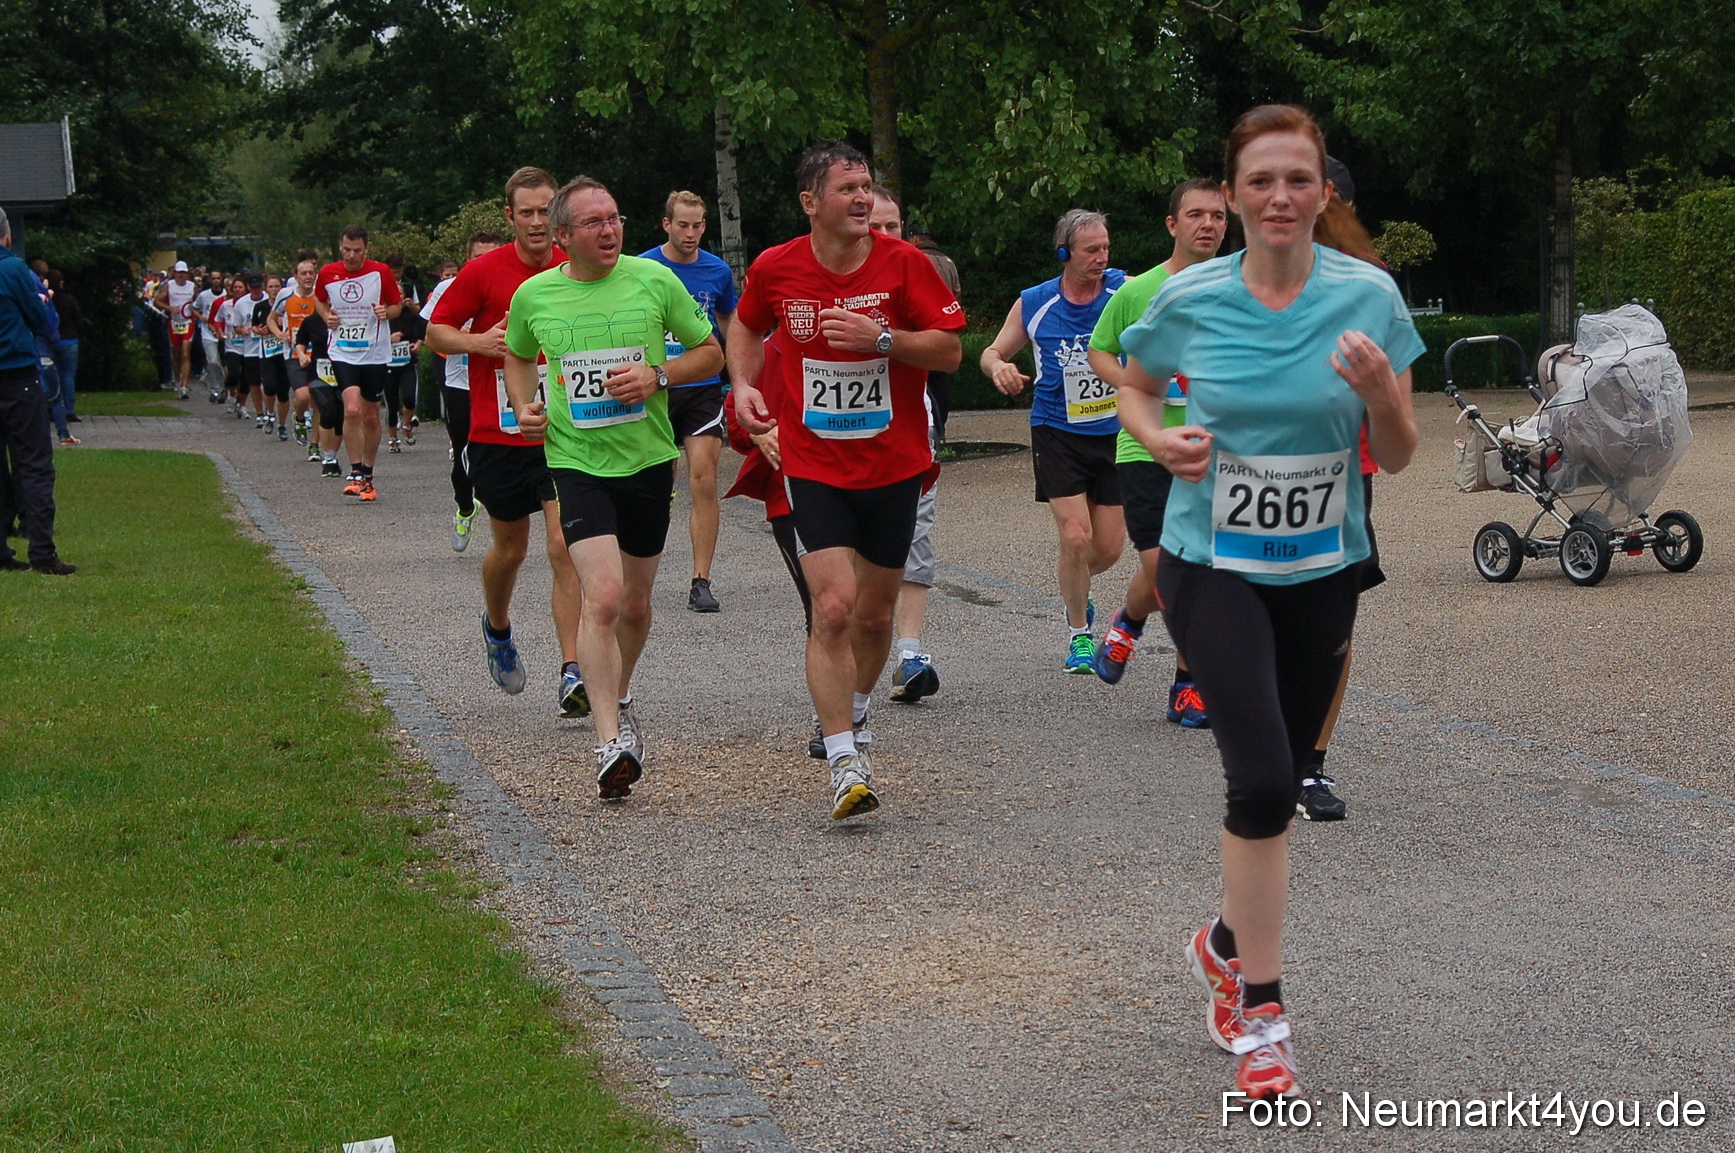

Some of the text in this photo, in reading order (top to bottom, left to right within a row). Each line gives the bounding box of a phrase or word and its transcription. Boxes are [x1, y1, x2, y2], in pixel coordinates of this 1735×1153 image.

[843, 299, 881, 310] STADTLAUF
[844, 292, 890, 304] NEUMARKTER
[790, 319, 814, 329] NEU
[338, 327, 366, 340] 2127
[562, 355, 630, 368] PARTL Neumarkt
[804, 365, 875, 378] PARTL Neumarkt
[1064, 370, 1086, 378] PARTL
[811, 378, 883, 410] 2124
[582, 405, 632, 417] wolfgang
[1079, 400, 1117, 414] Johannes
[827, 416, 866, 428] Hubert
[1218, 462, 1327, 481] PARTL Neumarkt
[1226, 481, 1336, 530] 2667
[1262, 540, 1298, 558] Rita
